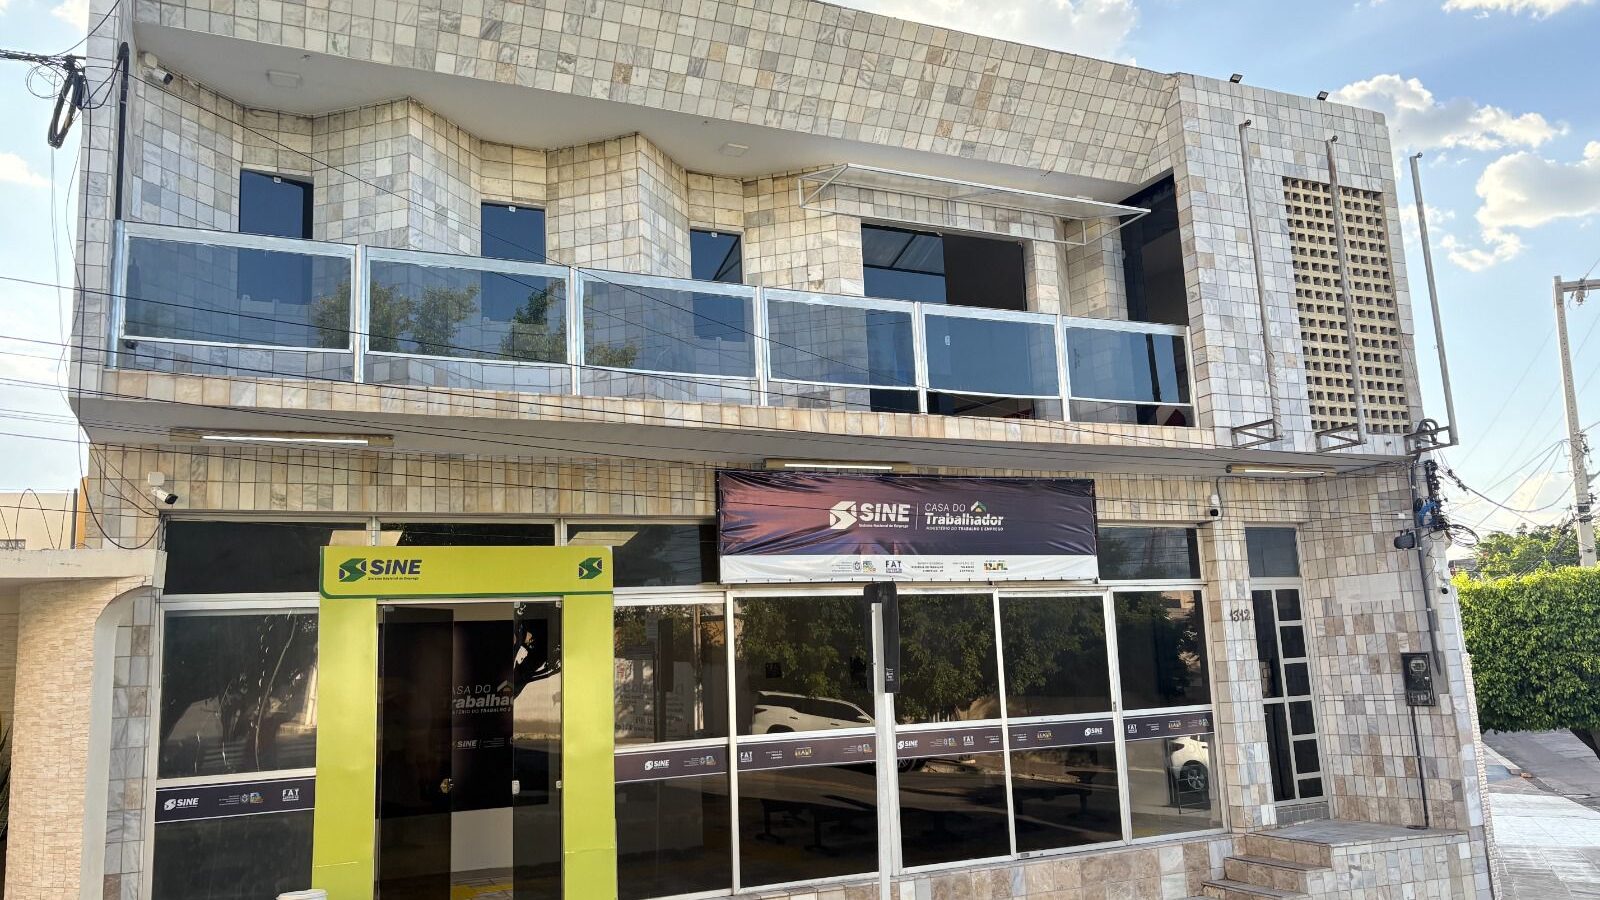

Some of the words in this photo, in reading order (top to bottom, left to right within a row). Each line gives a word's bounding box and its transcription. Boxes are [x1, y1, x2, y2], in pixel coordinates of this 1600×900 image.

[925, 503, 949, 512] CASA
[953, 503, 966, 512] DO
[925, 512, 1004, 526] Trabalhador
[885, 560, 902, 568] FAT
[475, 684, 491, 694] DO
[282, 788, 300, 797] FAT
